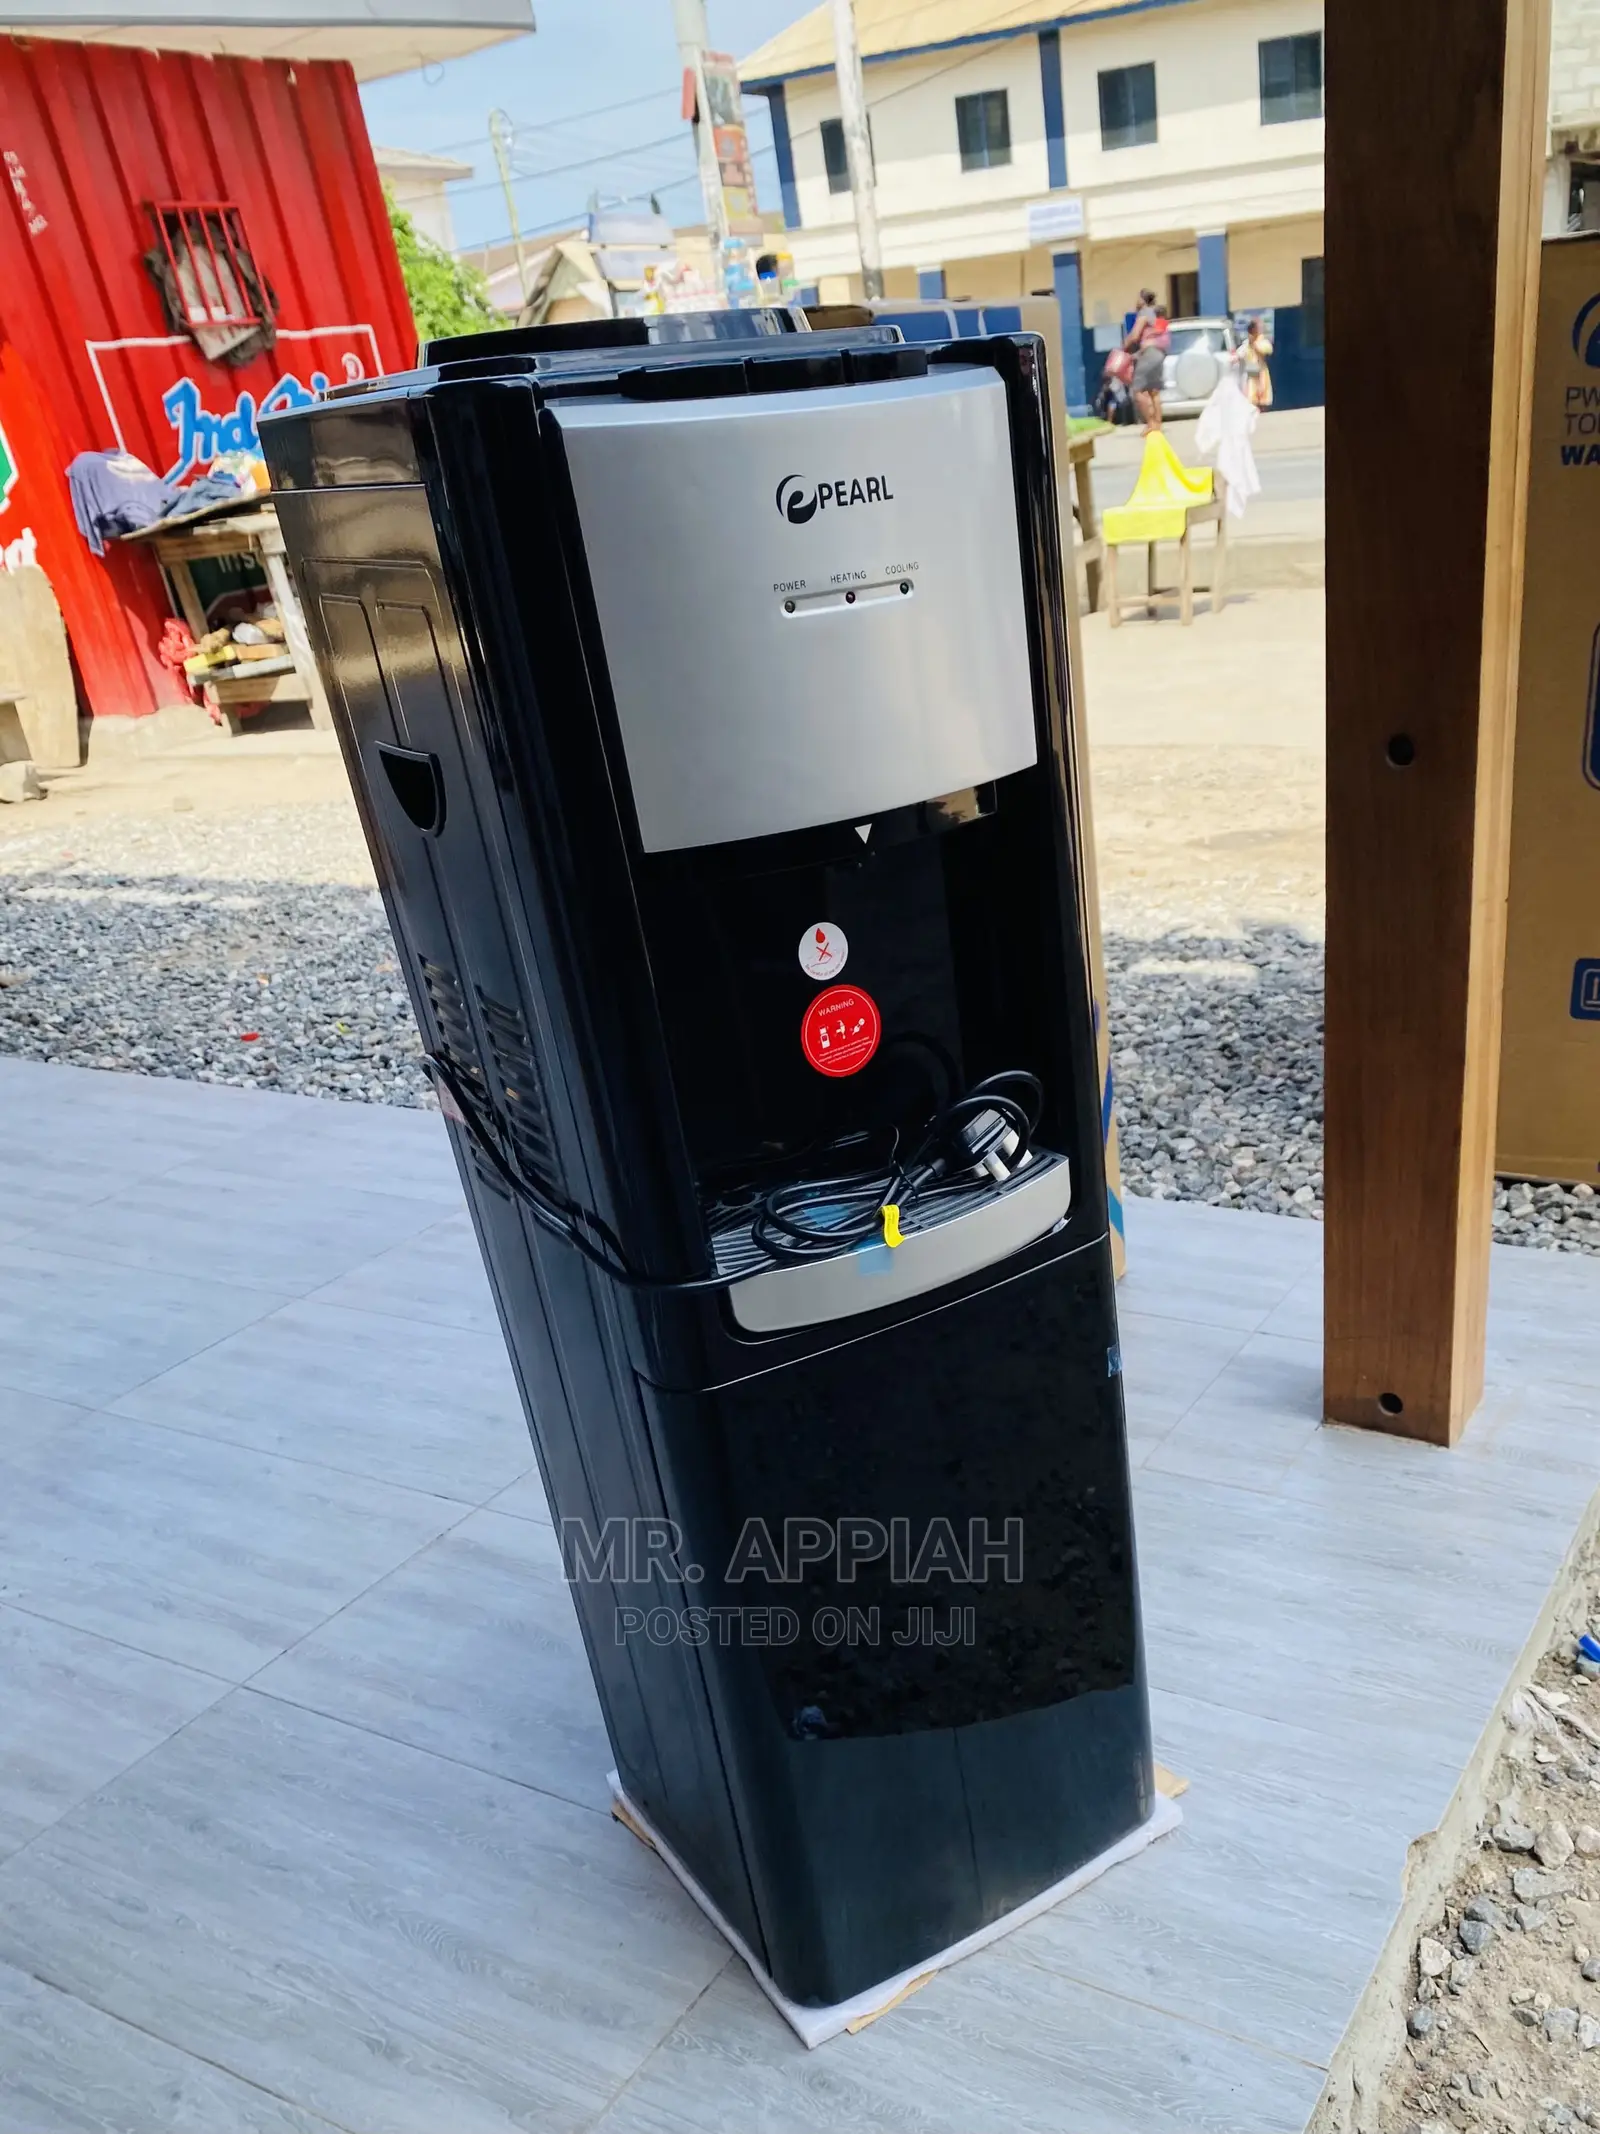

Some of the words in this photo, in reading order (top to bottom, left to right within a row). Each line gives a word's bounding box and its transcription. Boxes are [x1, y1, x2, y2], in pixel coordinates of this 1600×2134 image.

[1564, 412, 1600, 437] TO
[817, 475, 894, 510] PEARL
[773, 579, 807, 593] POWER
[830, 570, 867, 584] HEATING
[885, 561, 920, 575] COOLING
[818, 998, 855, 1017] WARNING
